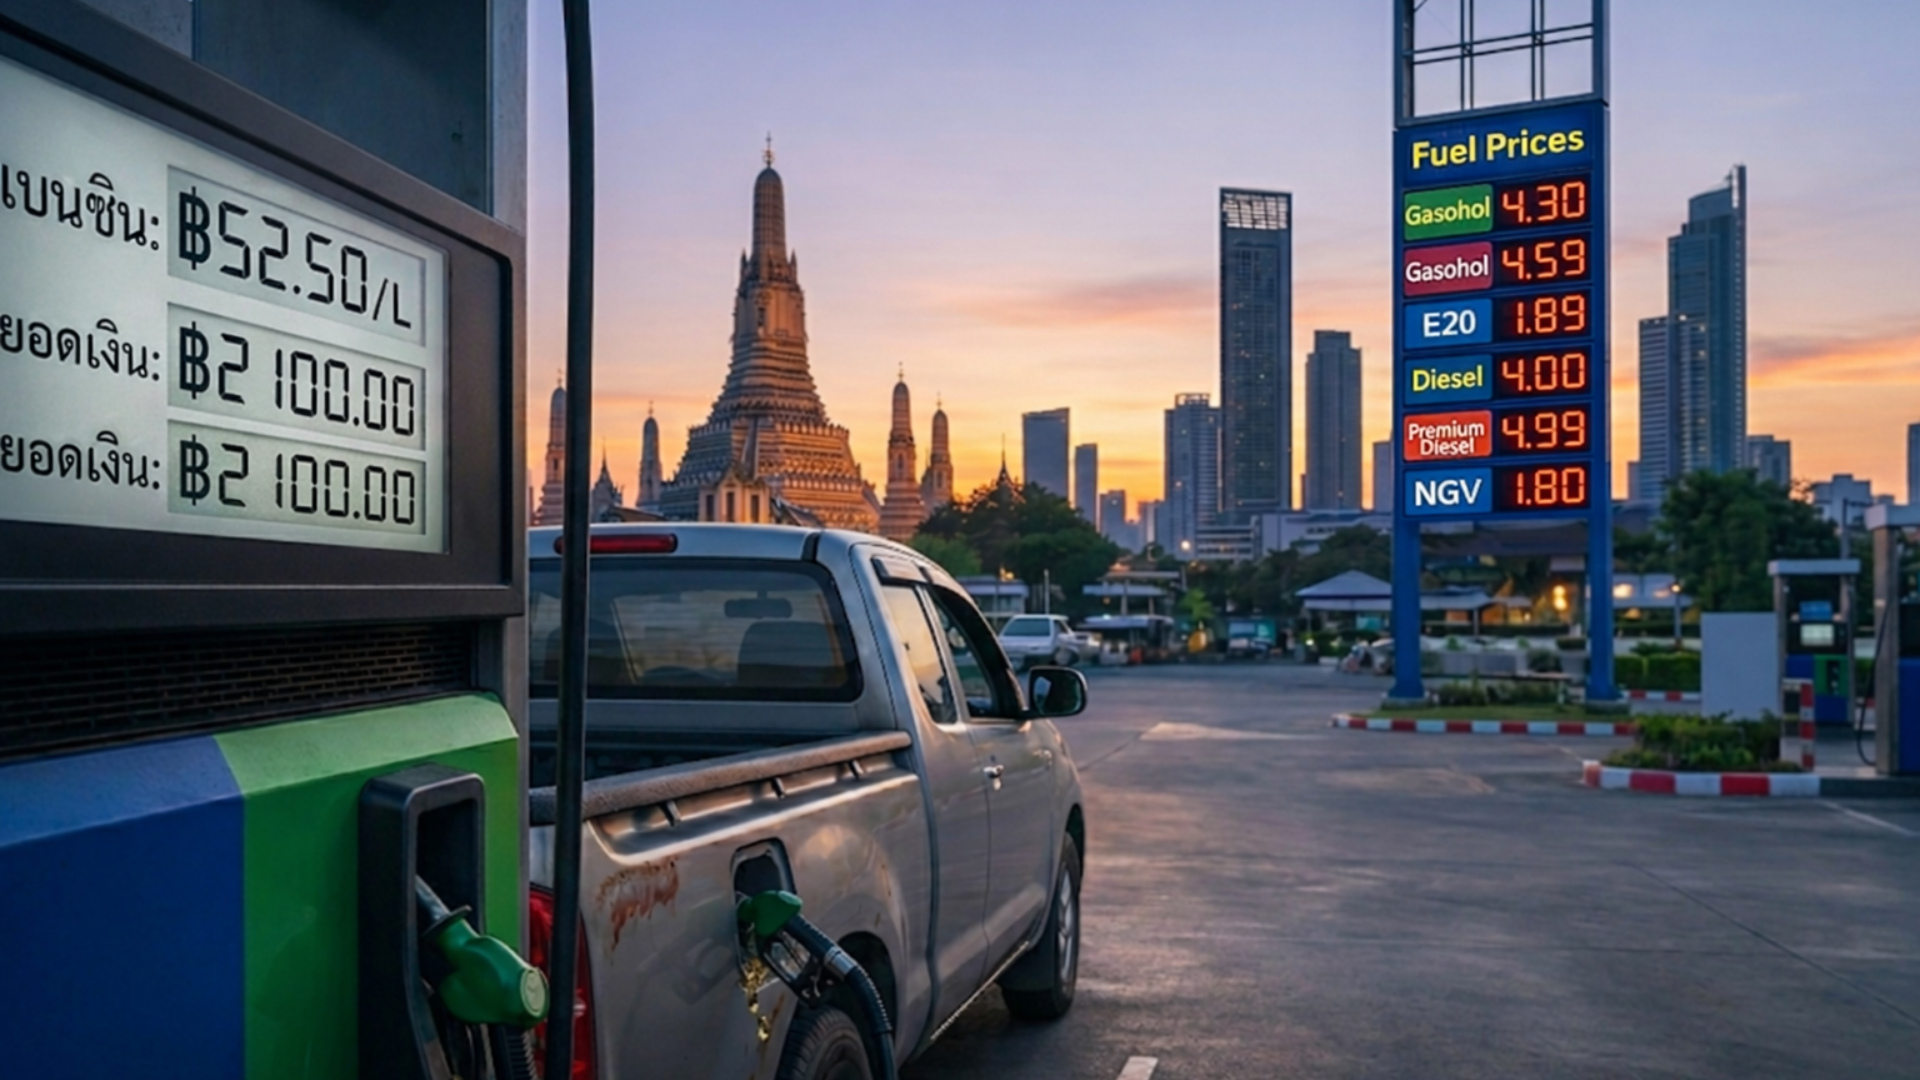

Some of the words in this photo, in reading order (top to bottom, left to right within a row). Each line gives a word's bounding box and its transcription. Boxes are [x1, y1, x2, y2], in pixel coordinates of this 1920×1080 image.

[1412, 134, 1477, 169] Fuel
[1486, 128, 1585, 161] Prices
[2, 163, 160, 251] เบนซิน:
[1405, 196, 1490, 225] Gasohol
[1502, 181, 1585, 223] 4.30
[1405, 254, 1489, 282] Gasohol
[1502, 239, 1585, 280] 4.59
[1423, 309, 1476, 338] E20
[1517, 294, 1585, 334] 1.89
[0, 314, 160, 381] ยอดเงิน:
[1412, 365, 1483, 392] Diesel
[1502, 353, 1585, 391] 4.00
[1408, 420, 1485, 441] Premium
[1502, 410, 1585, 448] 4.99
[1420, 437, 1474, 456] Diesel
[0, 430, 160, 490] ยอดเงิน:
[1415, 478, 1482, 506] NGV
[1517, 467, 1585, 505] 1.80
